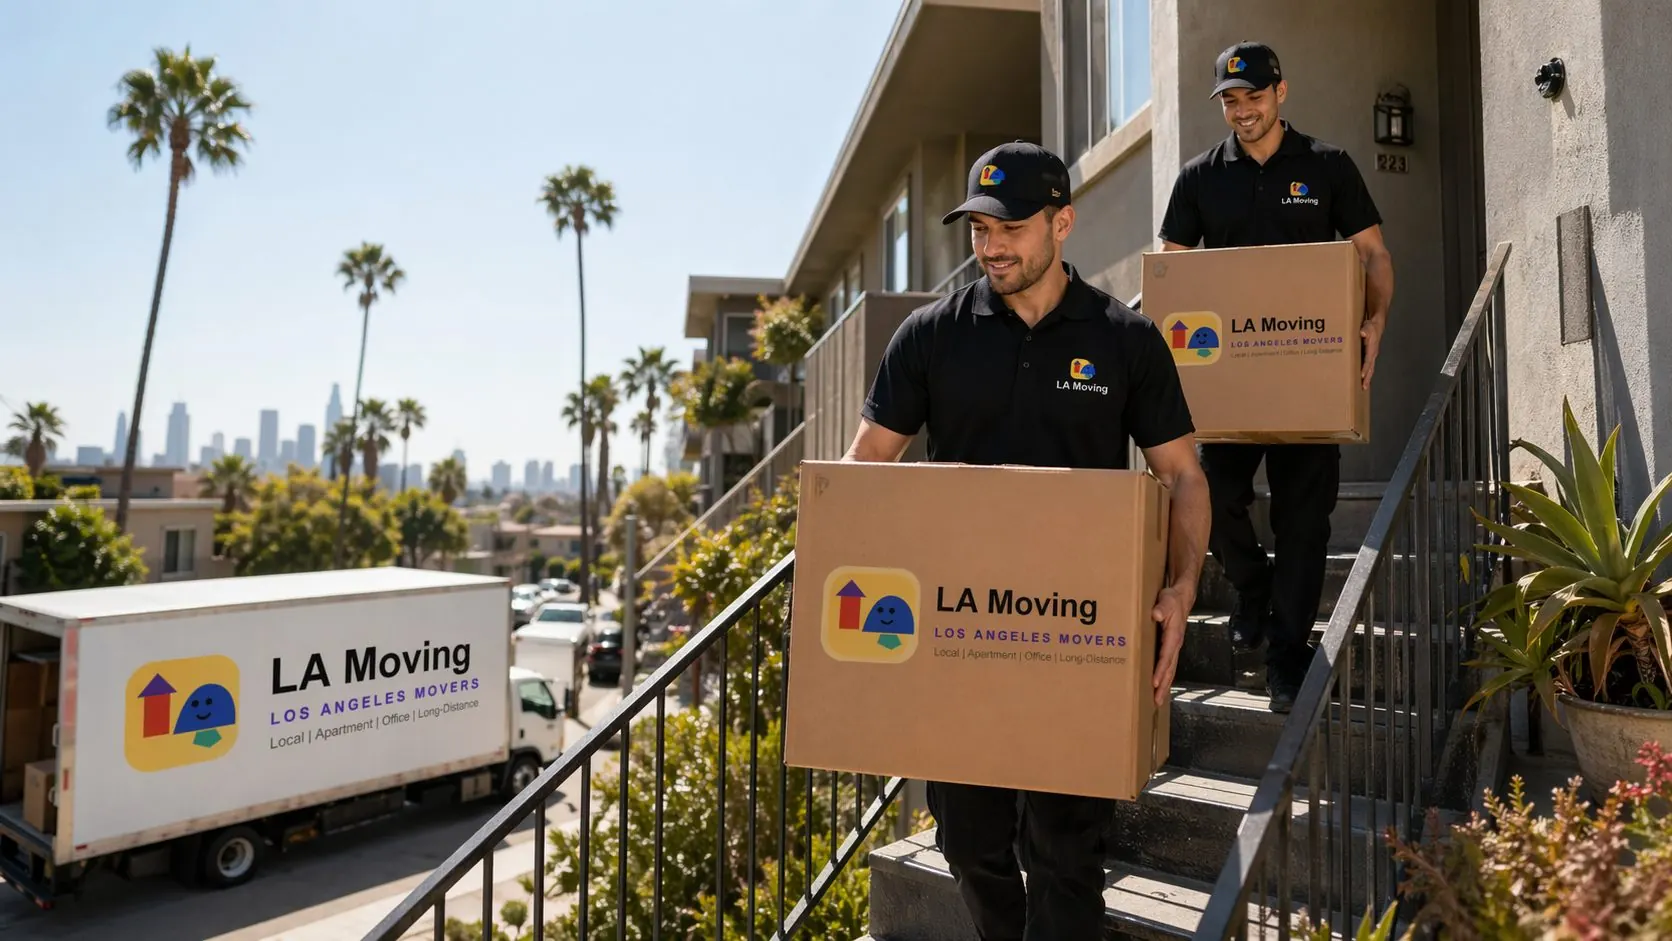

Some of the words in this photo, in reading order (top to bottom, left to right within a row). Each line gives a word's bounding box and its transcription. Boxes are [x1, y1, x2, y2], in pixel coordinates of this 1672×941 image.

[1377, 154, 1406, 171] 223
[1281, 197, 1292, 205] LA
[1293, 197, 1319, 206] Moving
[1231, 318, 1256, 333] LA
[1261, 316, 1325, 333] Moving
[1231, 340, 1249, 348] LOS
[1302, 336, 1343, 345] MOVERS
[1056, 380, 1070, 390] LA
[1072, 381, 1109, 395] Moving
[936, 586, 978, 613] LA
[988, 588, 1097, 625] Moving
[934, 627, 966, 639] LOS
[973, 629, 1051, 643] ANGELES
[1059, 633, 1127, 647] MOVERS
[933, 647, 960, 658] Local
[967, 649, 1017, 662] Apartment
[1024, 651, 1052, 662] Office
[1059, 652, 1127, 666] Long-Distance
[271, 652, 331, 695] LA
[344, 640, 471, 684] Moving
[270, 706, 310, 726] LOS
[320, 690, 406, 717] ANGELES
[414, 678, 480, 700] MOVERS
[269, 731, 305, 750] Local
[314, 719, 374, 741] Apartment
[382, 712, 410, 727] Office
[417, 699, 479, 719] Long-Distance
